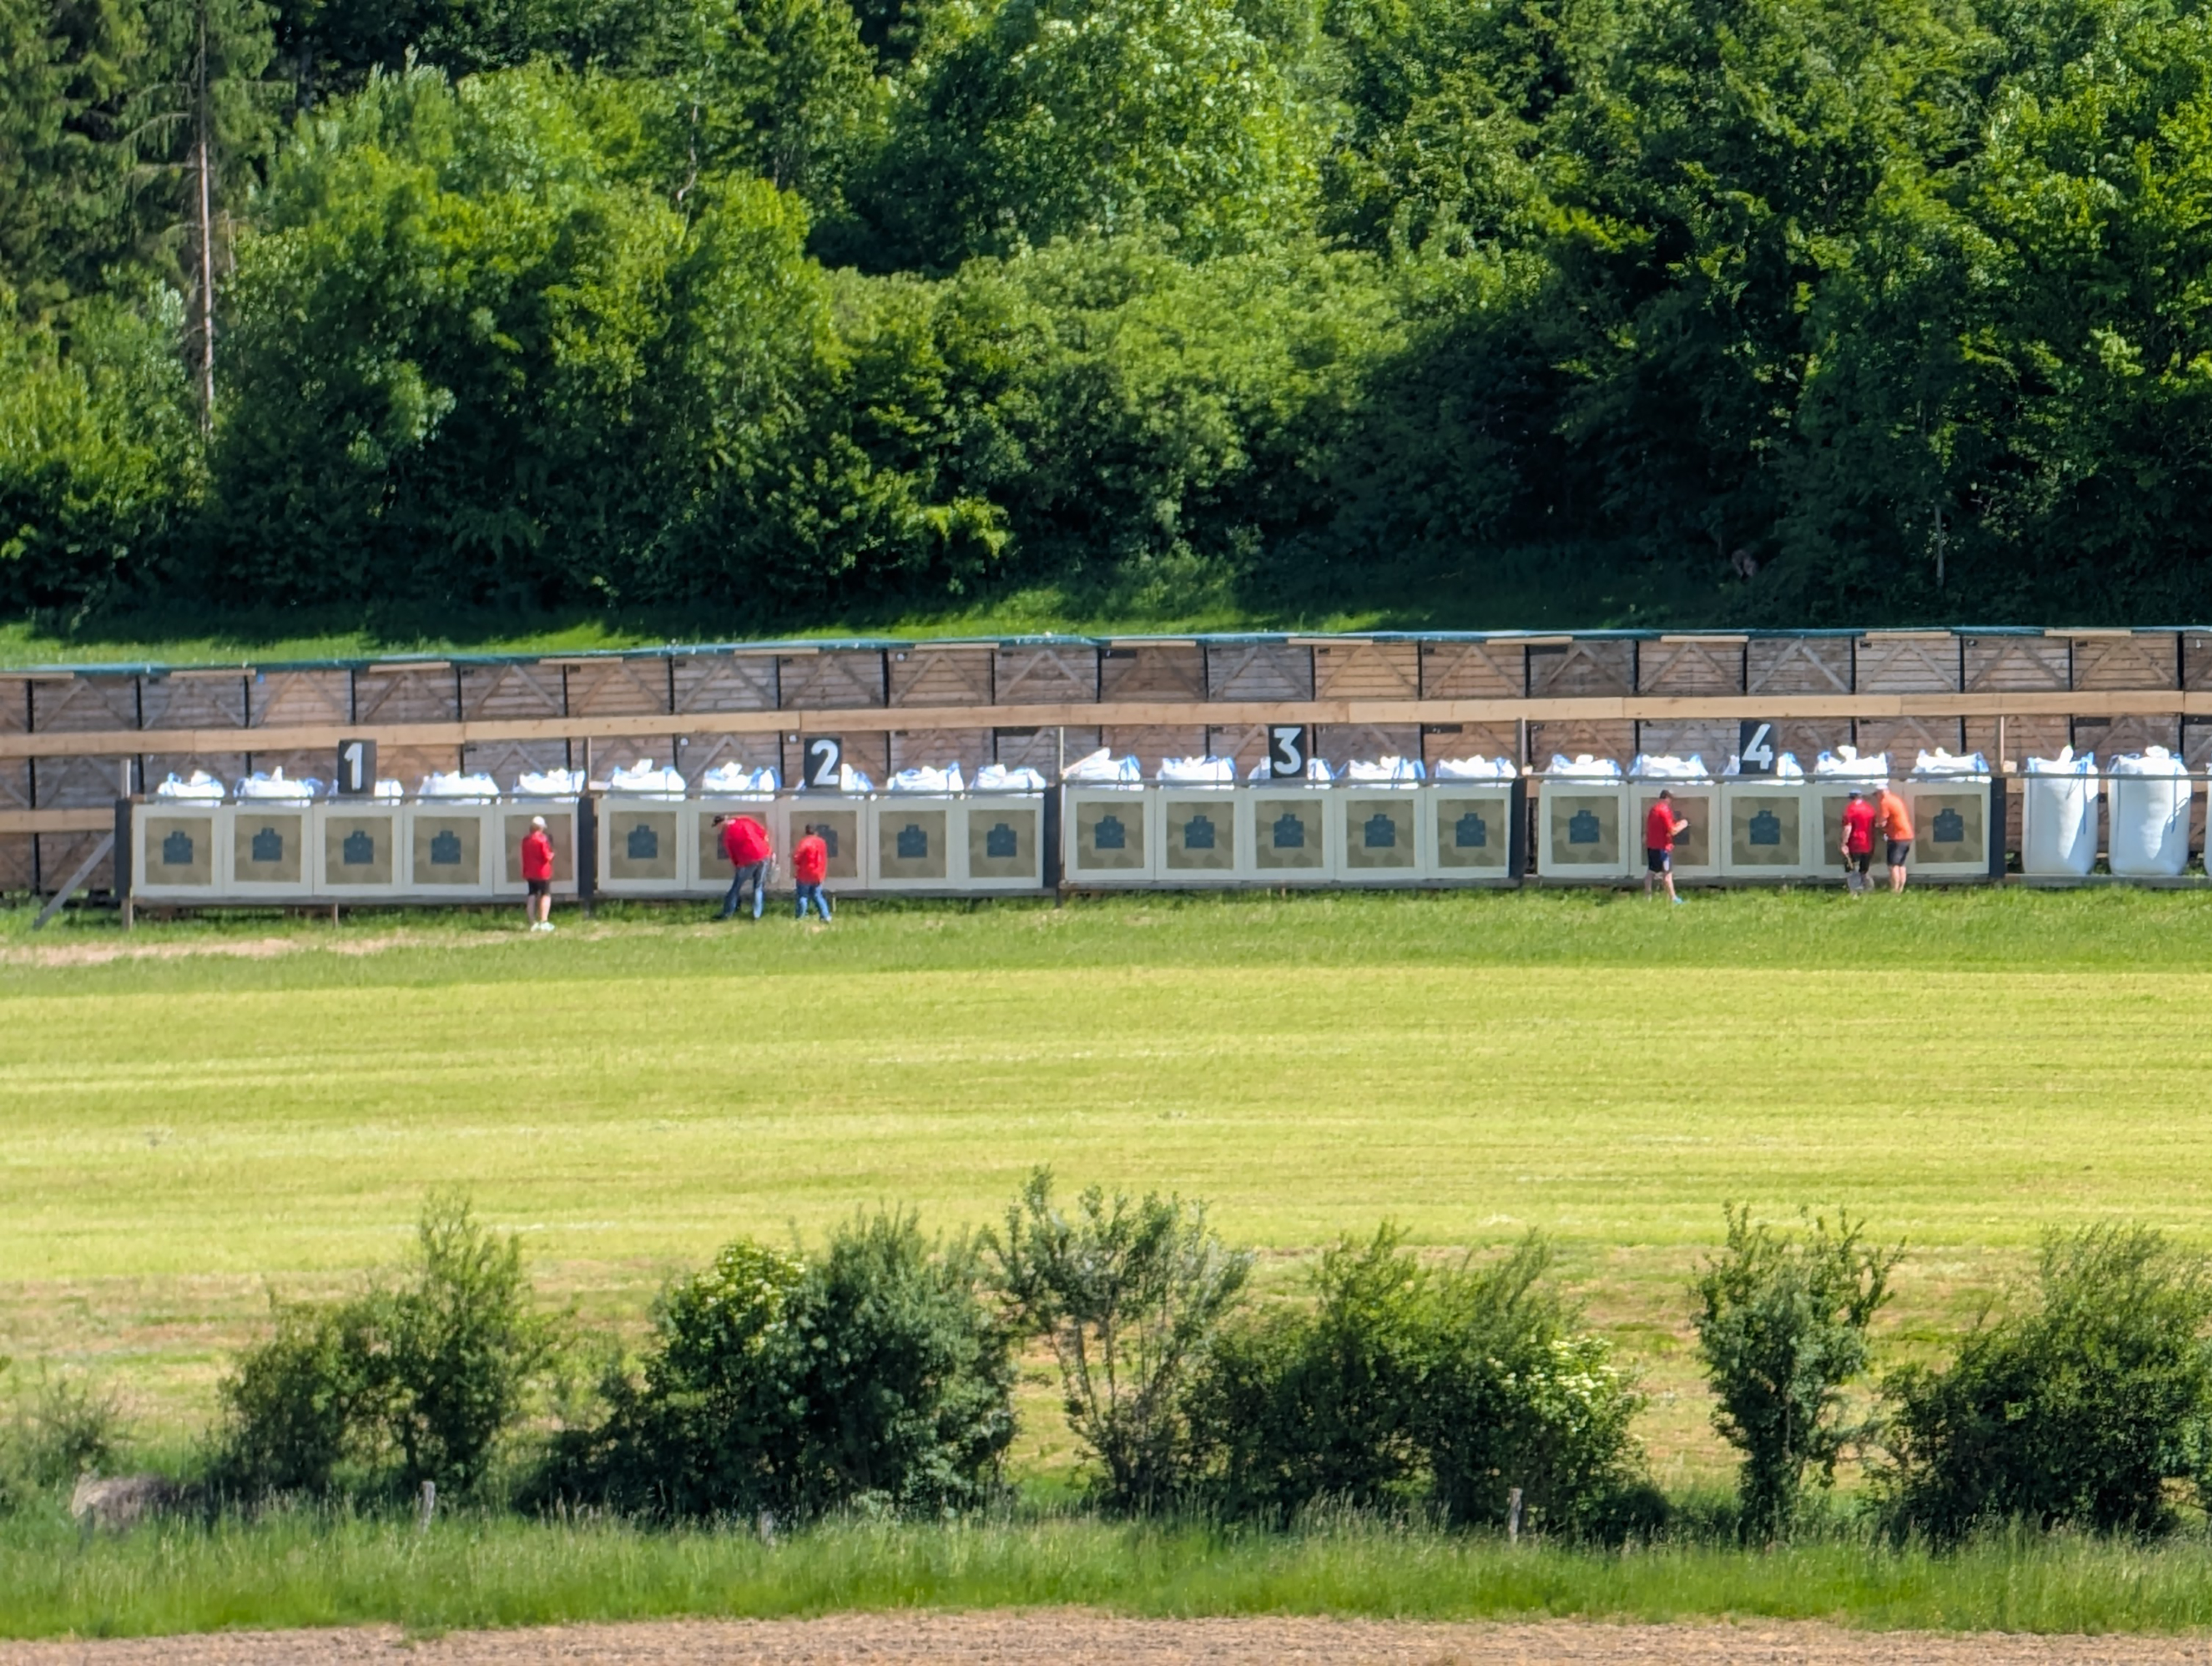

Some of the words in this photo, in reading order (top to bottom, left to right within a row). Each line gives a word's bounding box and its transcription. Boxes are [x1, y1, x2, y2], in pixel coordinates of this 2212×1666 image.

[344, 742, 363, 790] 1
[811, 740, 840, 785] 2
[1274, 728, 1302, 774] 3
[1742, 723, 1772, 770] 4
